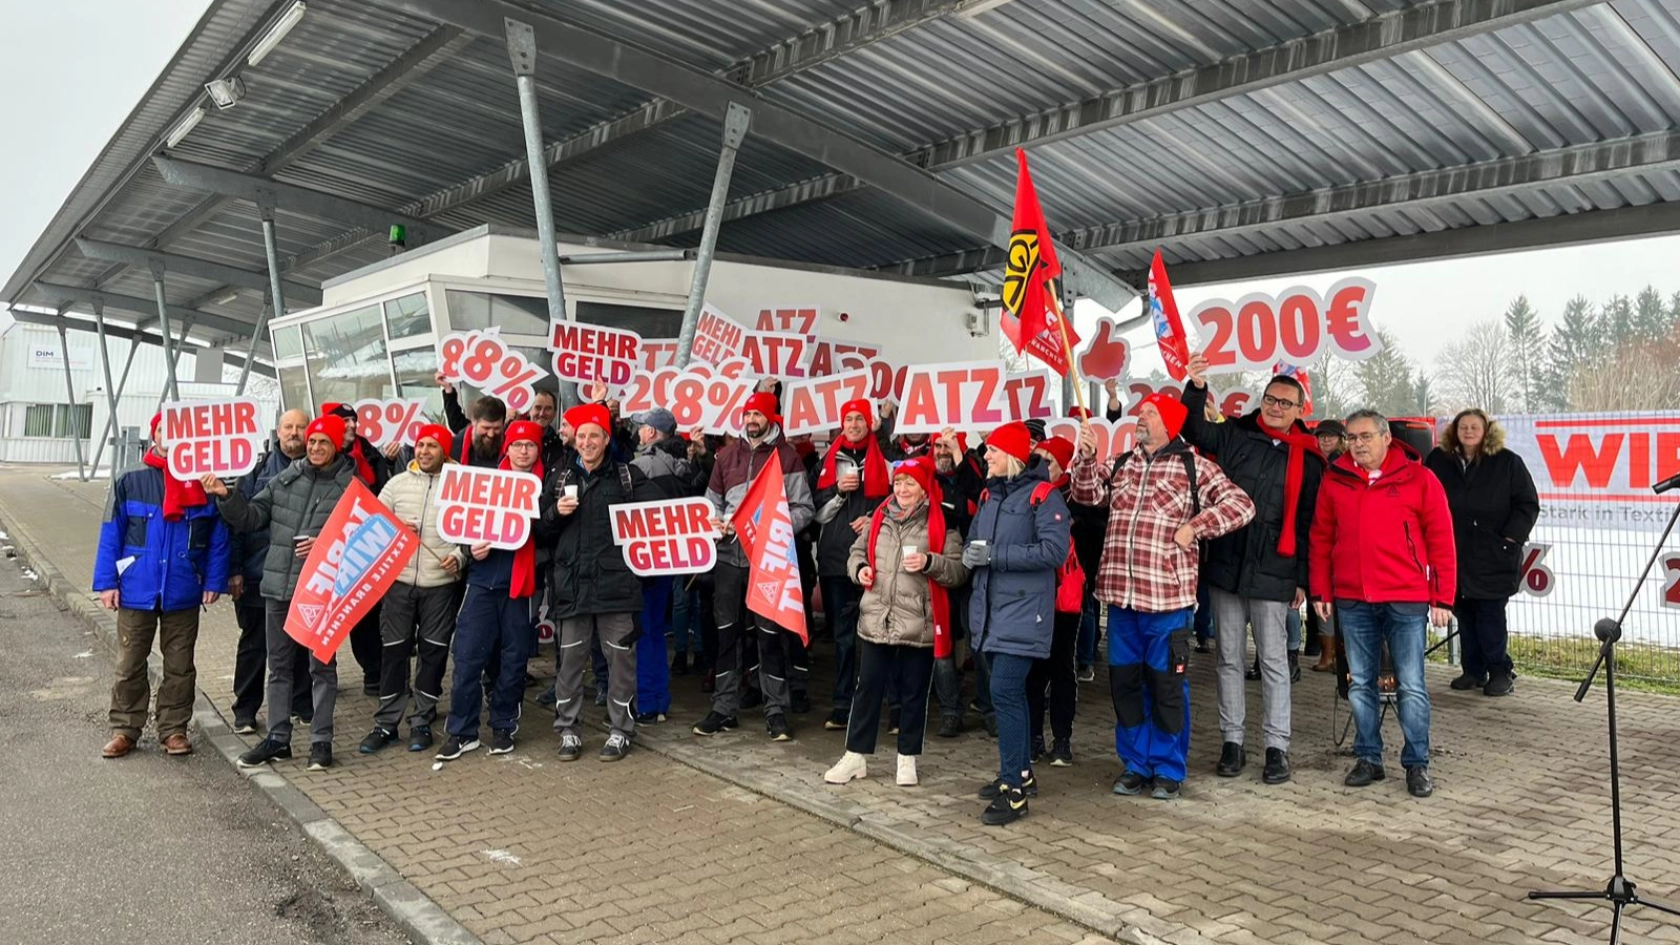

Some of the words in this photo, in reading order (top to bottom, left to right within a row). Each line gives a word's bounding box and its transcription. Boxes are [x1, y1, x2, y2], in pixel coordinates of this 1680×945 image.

[553, 324, 637, 360] MEHR
[697, 311, 742, 349] MEH
[756, 309, 816, 343] ATZ
[1197, 286, 1371, 366] 200€
[557, 352, 631, 385] GELD
[637, 343, 679, 373] TZ
[741, 335, 805, 378] ATZ
[1030, 339, 1064, 365] RANCHEN
[463, 340, 537, 409] 8%
[672, 379, 744, 431] 8%
[903, 367, 1002, 425] ATZ
[1003, 376, 1051, 421] TZ
[166, 402, 257, 439] MEHR
[357, 403, 425, 443] 8%
[173, 438, 252, 474] GELD
[441, 470, 536, 510] MEHR
[443, 505, 524, 544] GELD
[615, 503, 713, 539] MEHR
[1539, 504, 1587, 520] Stark
[1596, 505, 1613, 520] in
[628, 537, 711, 570] GELD
